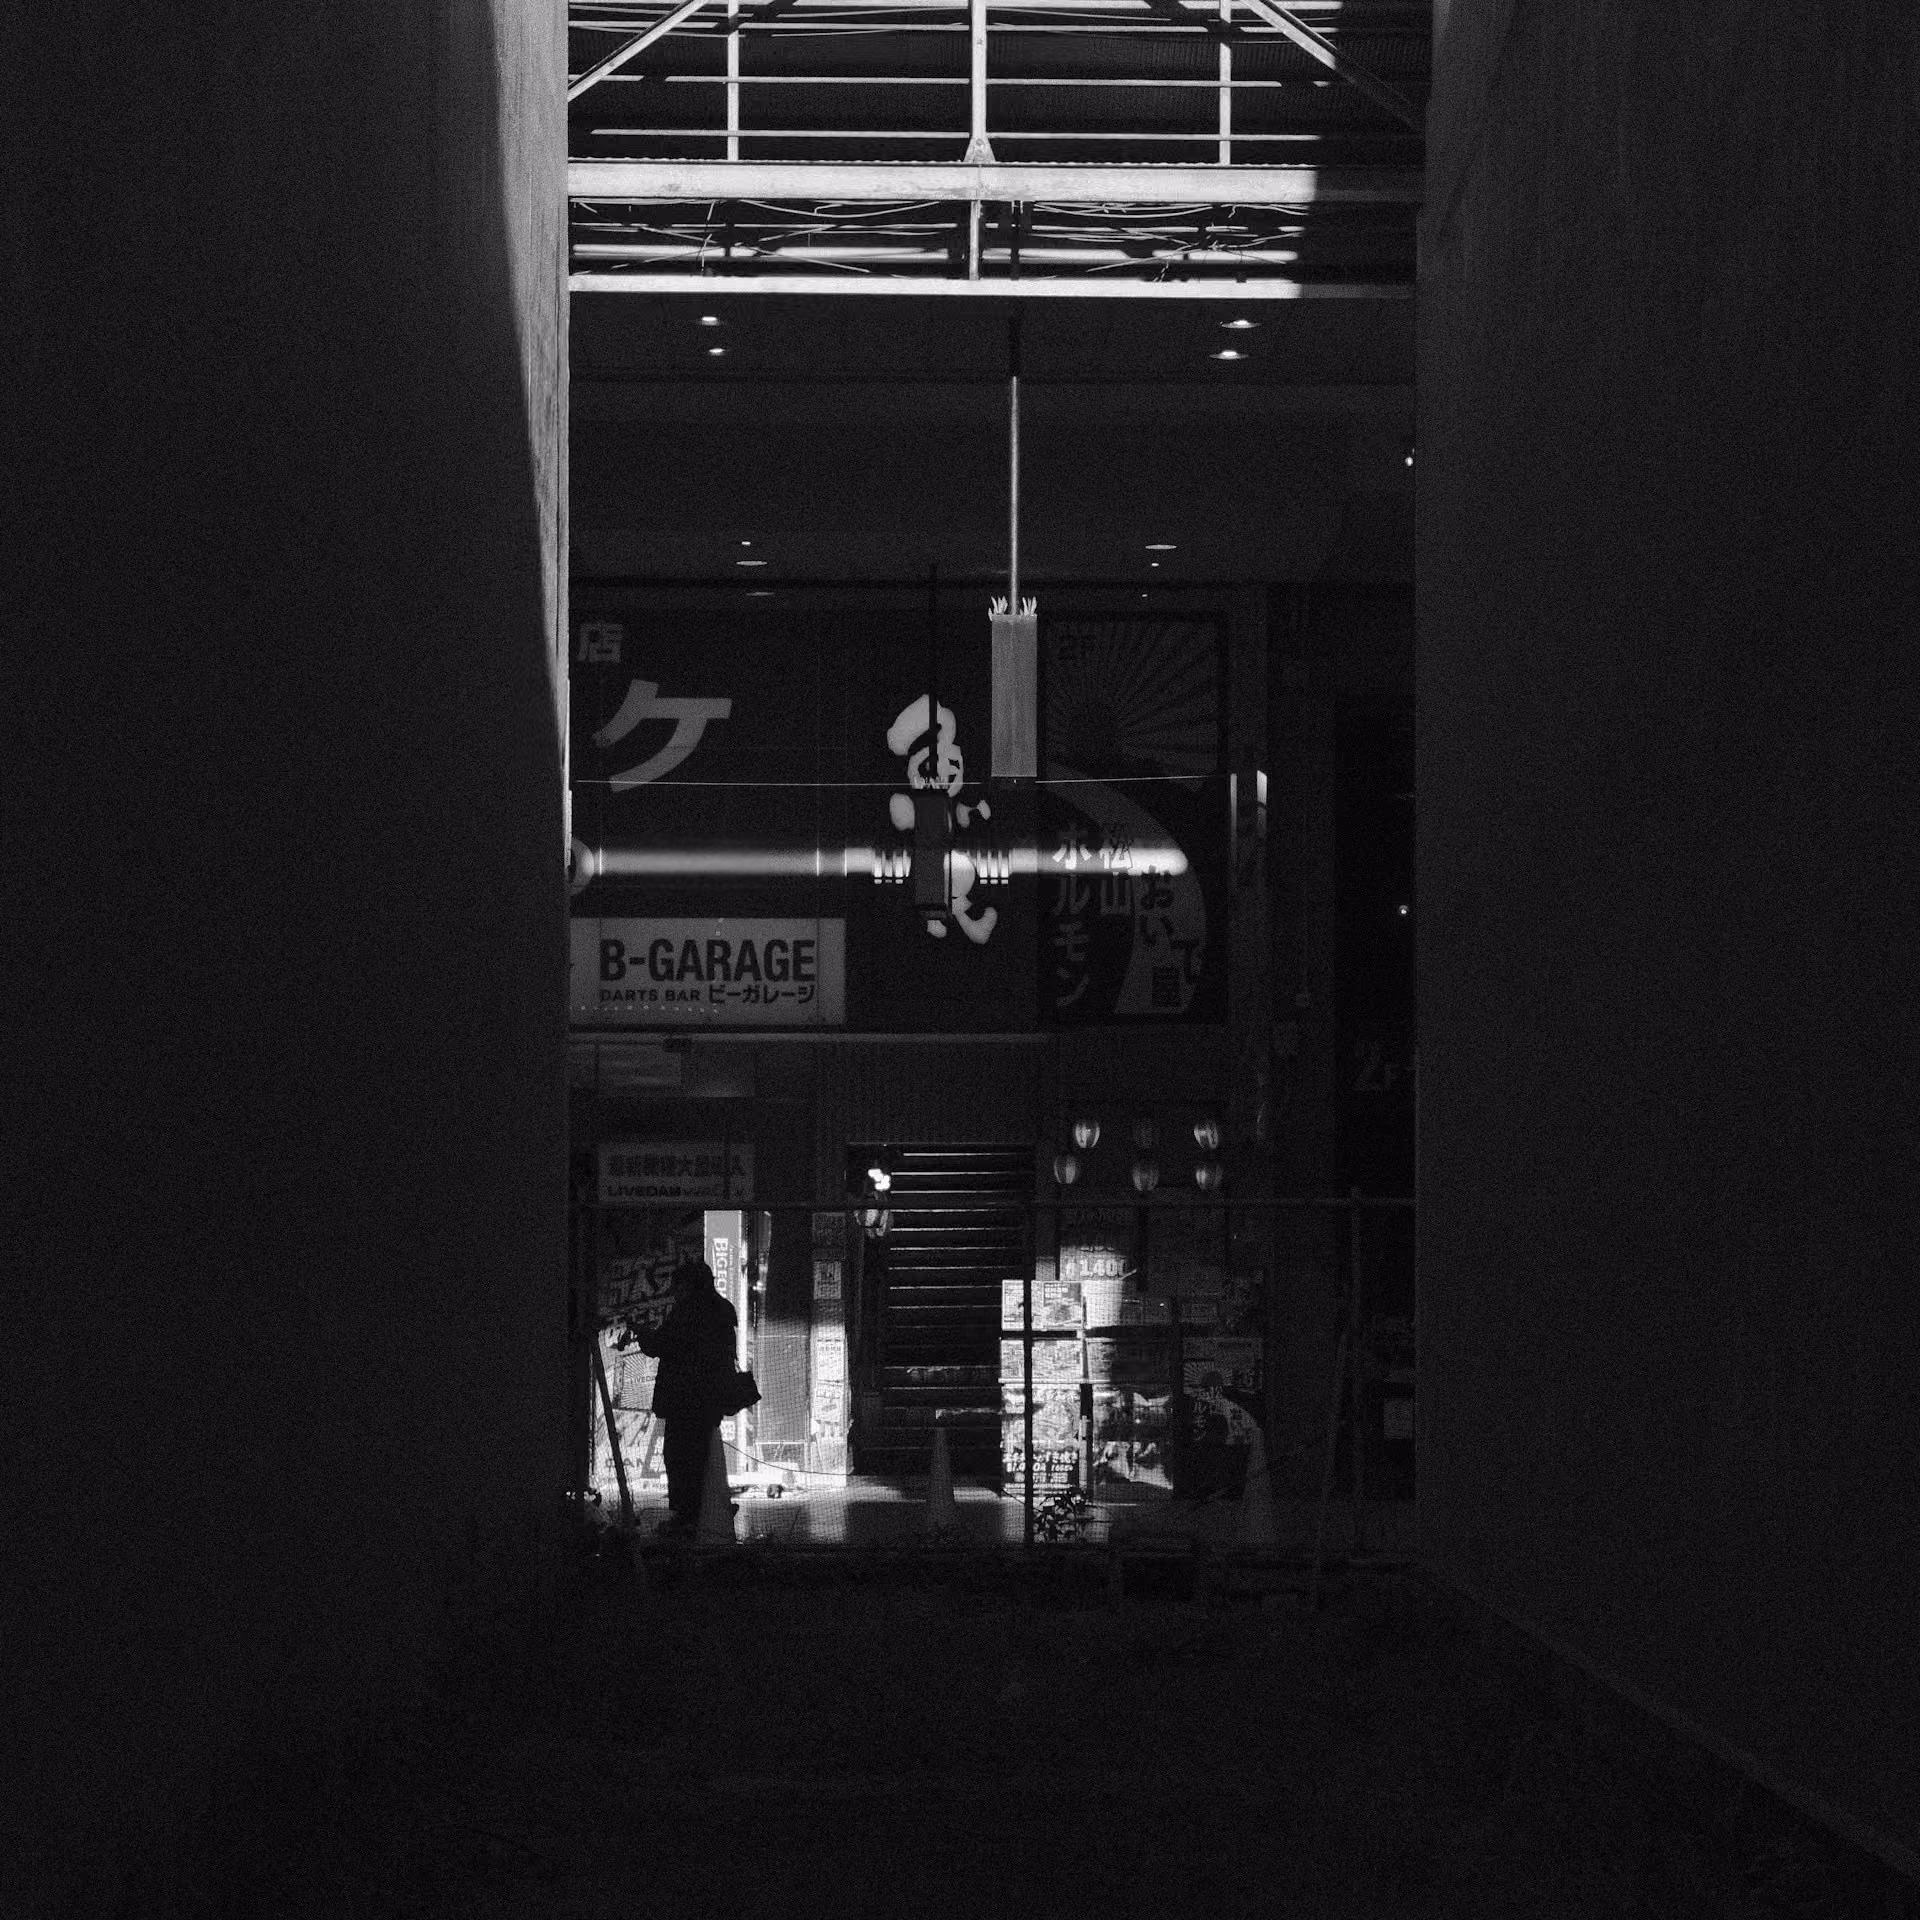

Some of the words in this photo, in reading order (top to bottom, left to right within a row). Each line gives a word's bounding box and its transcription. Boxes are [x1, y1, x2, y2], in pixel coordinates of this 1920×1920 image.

[577, 622, 623, 663] 店
[590, 678, 733, 793] ケ
[599, 938, 816, 982] B-GARAGE
[599, 989, 659, 1002] DARTS
[665, 989, 701, 1002] BAR
[708, 984, 816, 1005] ビーガレージ
[607, 1185, 682, 1197] LIVEDAM
